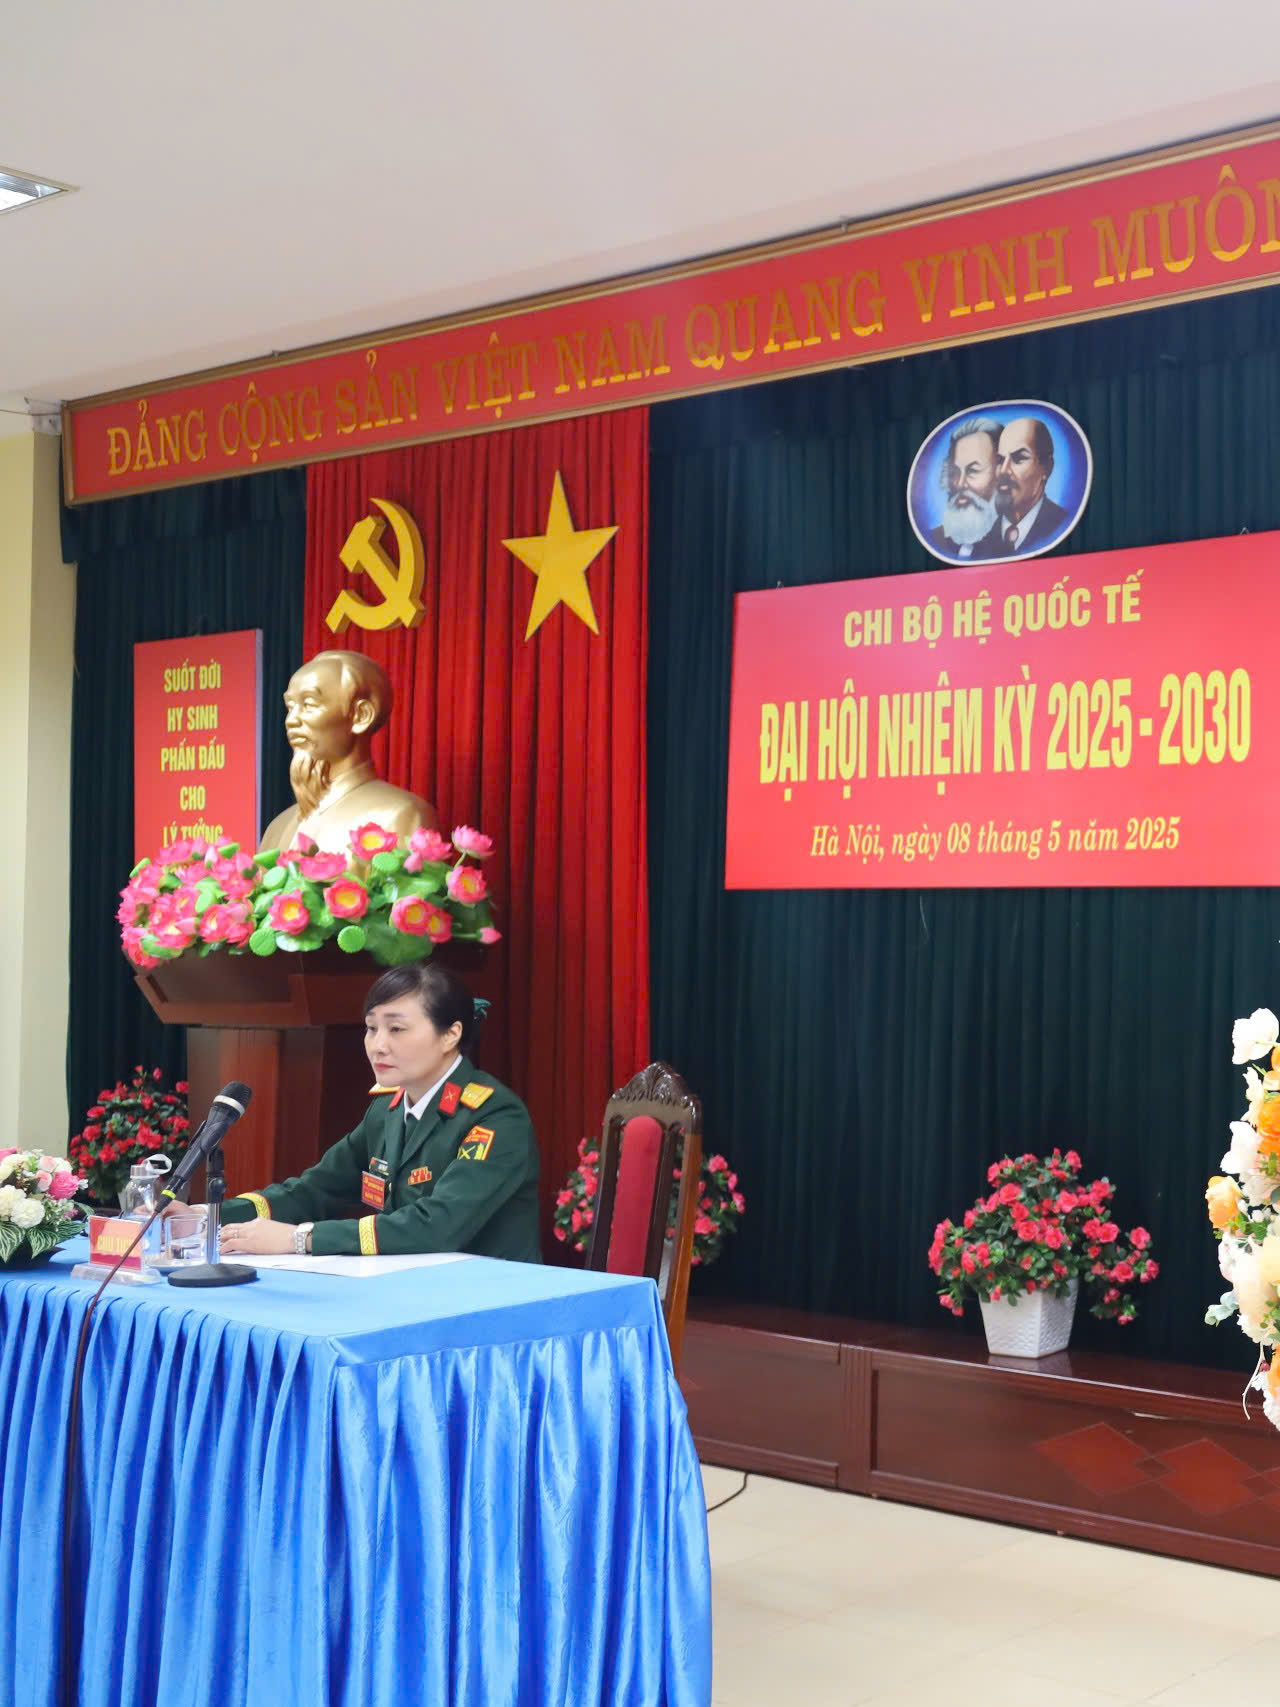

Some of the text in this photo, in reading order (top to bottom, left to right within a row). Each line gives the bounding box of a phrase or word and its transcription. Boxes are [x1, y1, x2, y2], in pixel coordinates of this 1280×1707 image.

[107, 400, 208, 476] ĐẢNG
[218, 381, 323, 463] CỘNG
[336, 349, 419, 434] SẢN
[432, 331, 539, 418] VIỆT
[552, 314, 671, 394] NAM
[685, 267, 887, 370] QUANG
[903, 225, 1073, 323] VINH
[843, 569, 1145, 649] CHI BỘ HỆ QUỐC TẾ
[164, 658, 196, 693] SUỐT
[167, 704, 218, 733] HY SINH
[759, 701, 808, 801] ĐẠI
[817, 679, 868, 800] HỘI
[877, 672, 982, 796] NHIỆM
[993, 664, 1037, 773] KỲ
[161, 736, 225, 771] PHẤN ĐẤU
[180, 785, 206, 811] CHO
[810, 816, 1181, 864] Hà Nội, ngày 08 tháng 5 năm 2025
